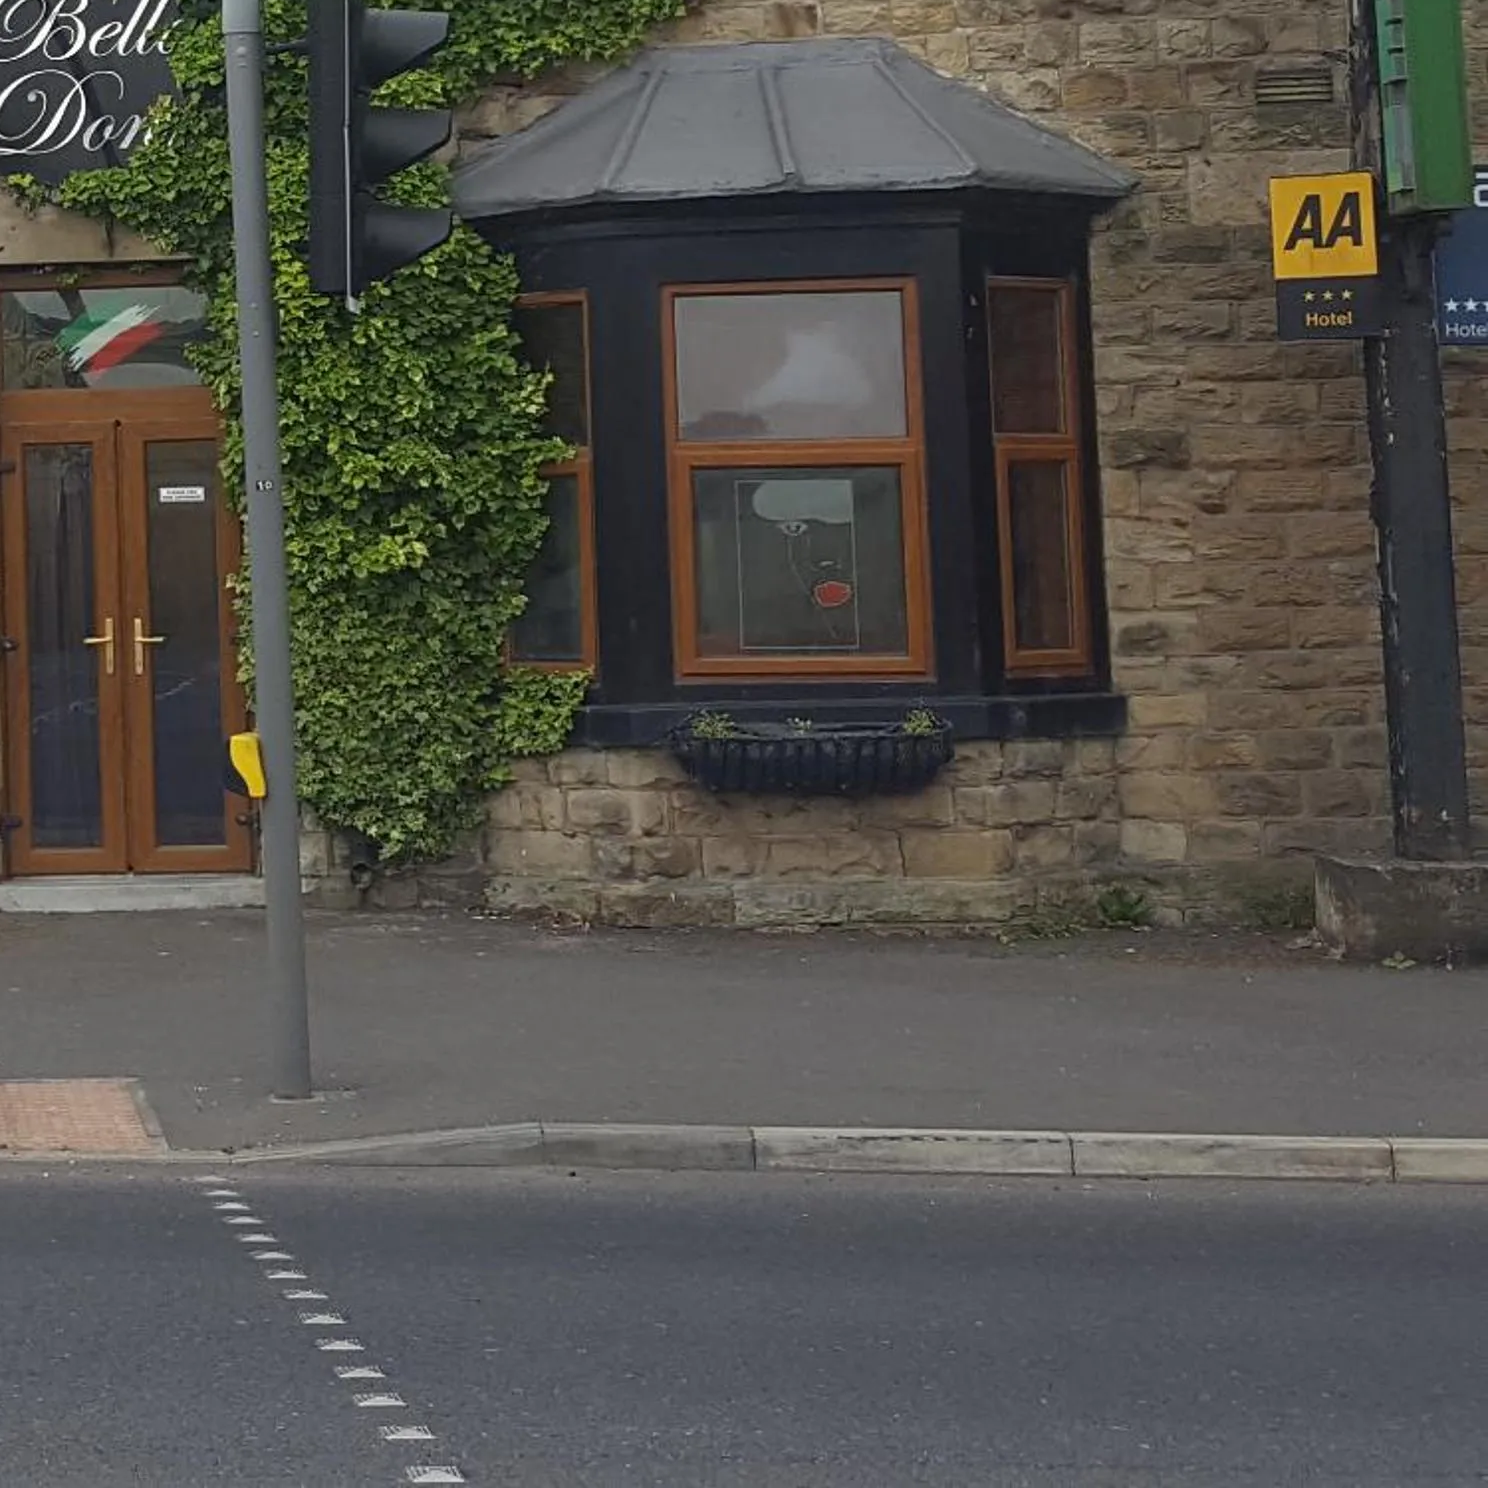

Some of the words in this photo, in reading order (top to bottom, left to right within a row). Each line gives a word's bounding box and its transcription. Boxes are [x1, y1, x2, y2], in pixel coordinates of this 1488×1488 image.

[1284, 191, 1363, 250] AA
[1305, 311, 1352, 327] Hotel
[1445, 322, 1488, 338] Hote
